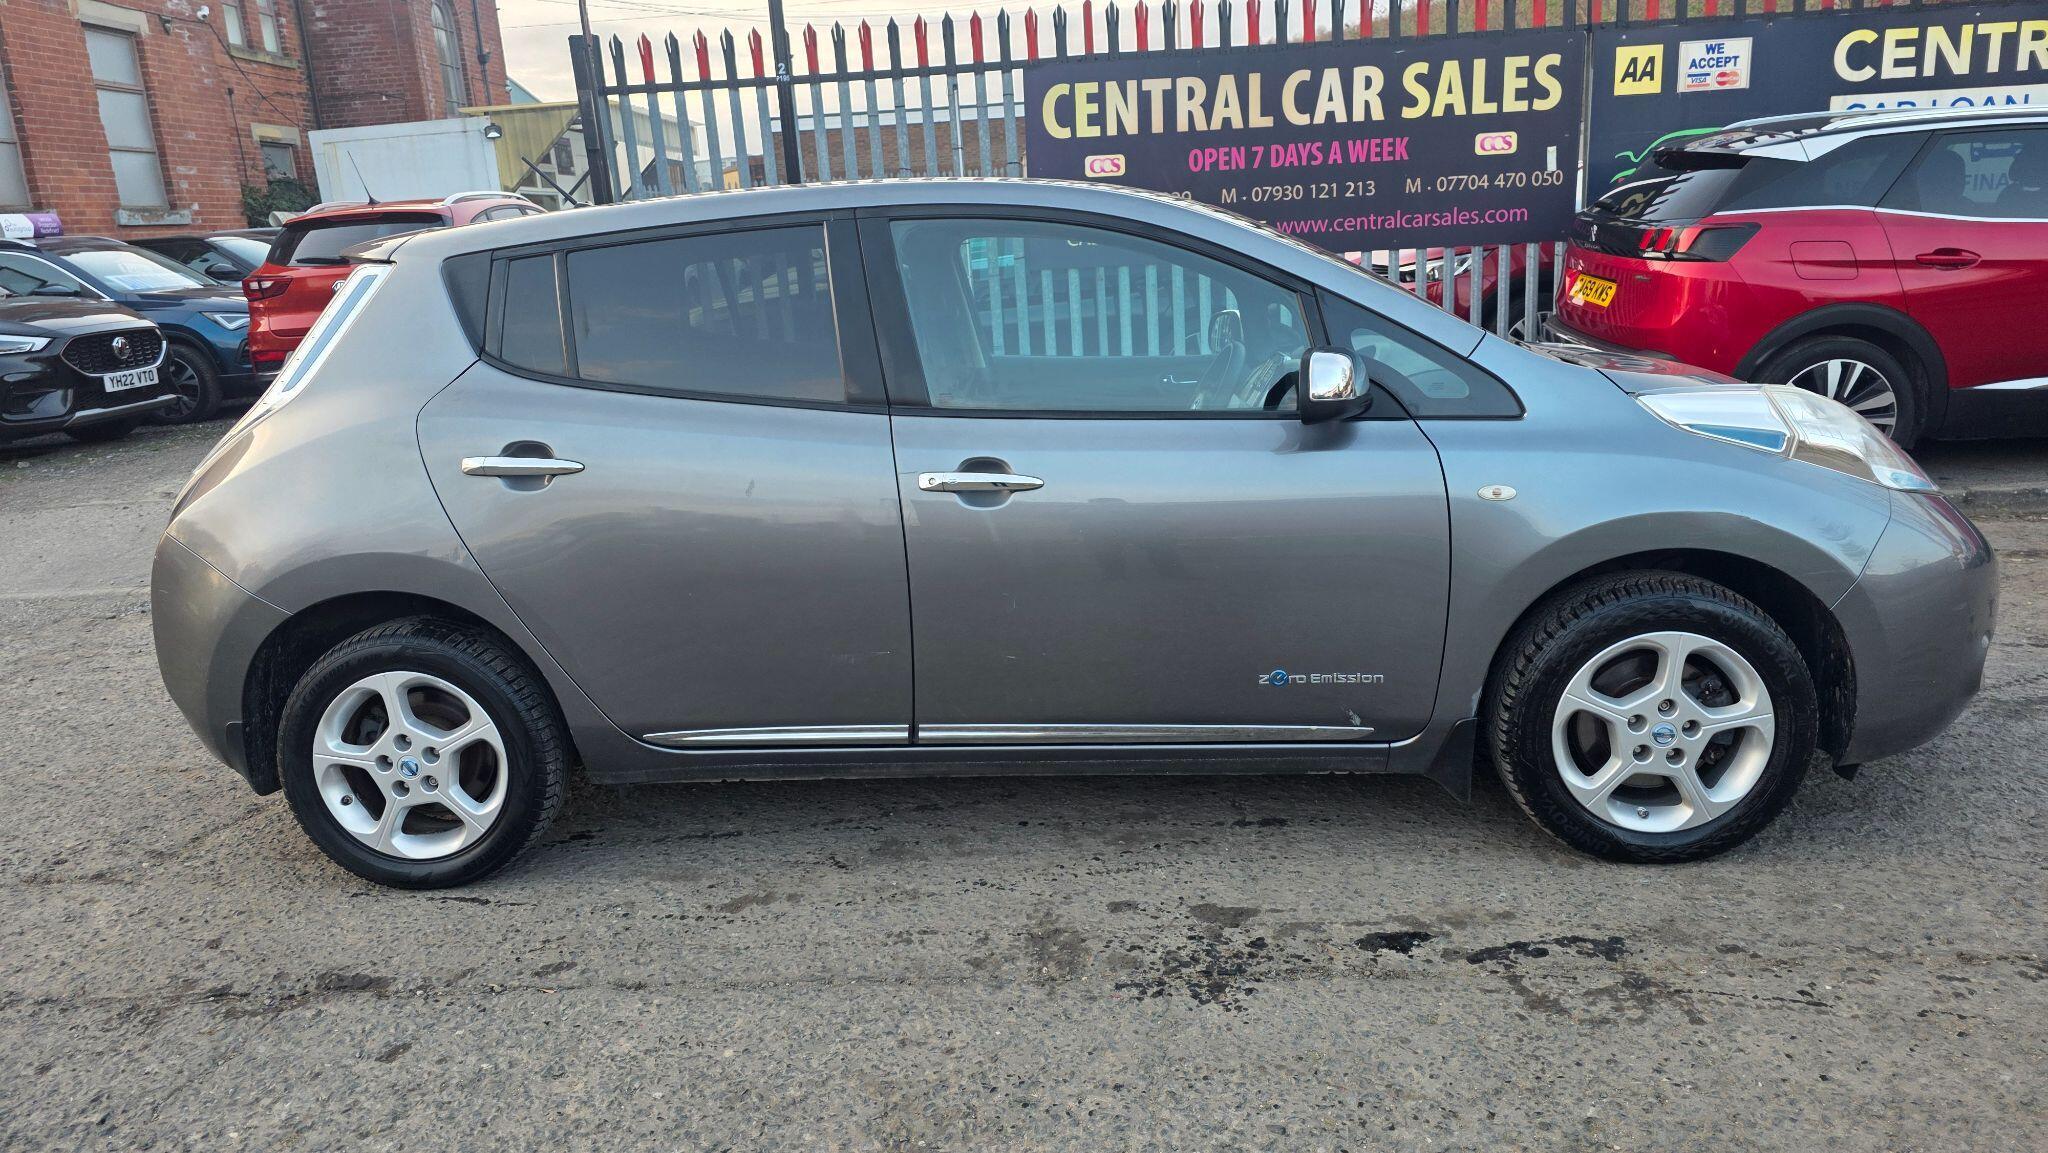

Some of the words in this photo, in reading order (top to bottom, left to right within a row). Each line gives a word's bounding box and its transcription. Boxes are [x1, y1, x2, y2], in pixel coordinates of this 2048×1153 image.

[1706, 43, 1724, 54] WE
[778, 62, 786, 75] 2
[1620, 56, 1656, 83] AA
[1689, 56, 1739, 69] ACCEPT
[1042, 73, 1274, 139] CENTRAL
[1282, 66, 1385, 126] CAR
[1401, 53, 1563, 119] SALES
[1189, 146, 1245, 172] OPEN
[1252, 146, 1264, 169] 7
[1270, 142, 1324, 168] DAYS
[1328, 141, 1343, 165] A
[1348, 137, 1410, 163] WEEK
[1251, 184, 1303, 202] 07930
[1310, 182, 1337, 199] 121
[1344, 180, 1376, 197] 213
[1436, 174, 1489, 192] 07704
[1494, 172, 1526, 189] 470
[1531, 170, 1564, 186] 050
[1277, 207, 1528, 234] www.centralcarsales.com
[109, 373, 135, 389] YH22
[1310, 672, 1384, 684] Emission
